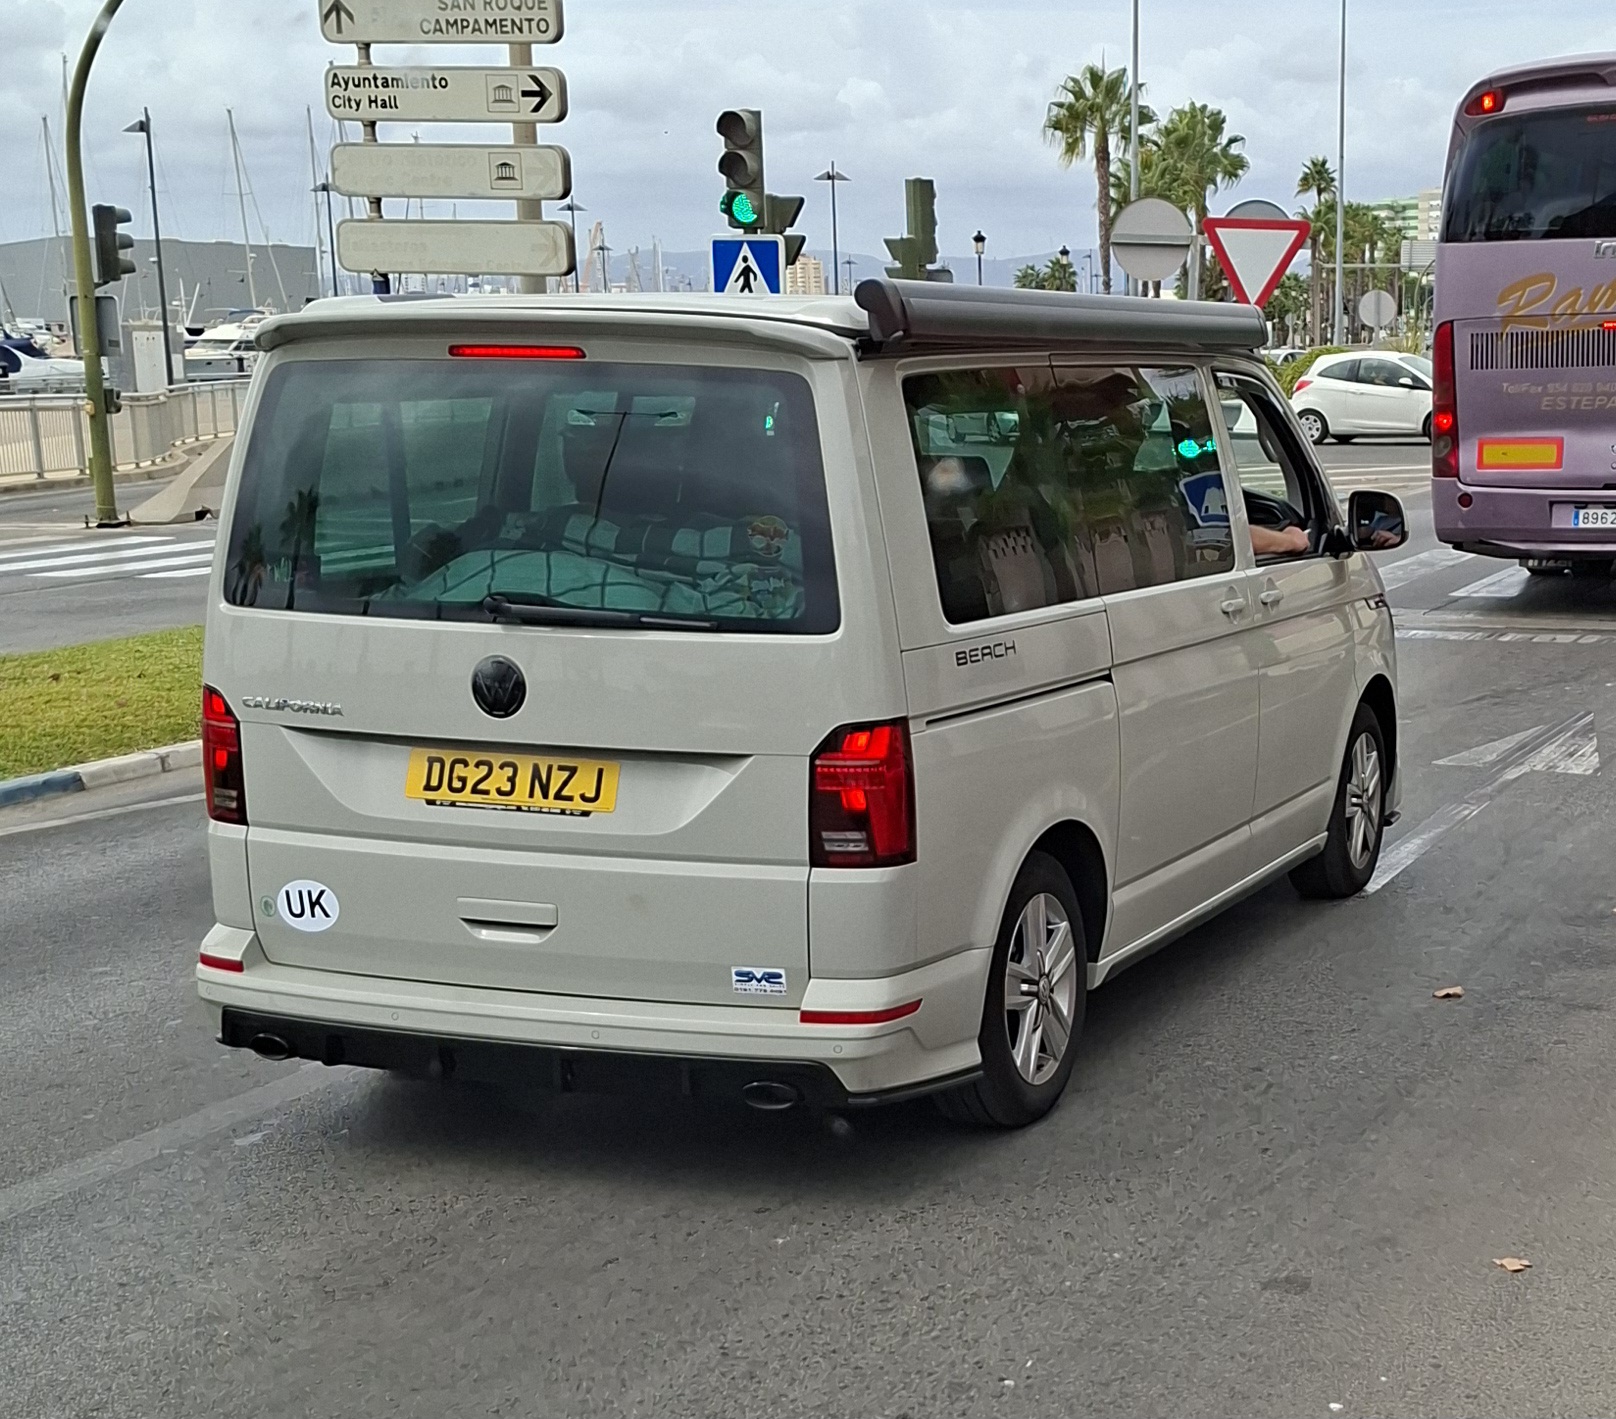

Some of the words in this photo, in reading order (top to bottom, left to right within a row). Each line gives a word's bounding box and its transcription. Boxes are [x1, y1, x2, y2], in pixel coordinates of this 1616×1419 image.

[438, 0, 475, 11] SAN
[484, 0, 548, 11] ROQUE
[420, 18, 549, 35] CAMPAMENTO
[331, 72, 449, 92] Ayuntamiento
[332, 94, 362, 113] City
[368, 94, 399, 110] Hall
[1541, 396, 1616, 411] ESTEPA
[1582, 511, 1616, 525] 8962
[955, 639, 1017, 667] BEACH
[241, 696, 344, 716] CALIFORNIA
[422, 755, 519, 797] DG23
[528, 762, 604, 803] NZJ
[285, 889, 332, 919] UK
